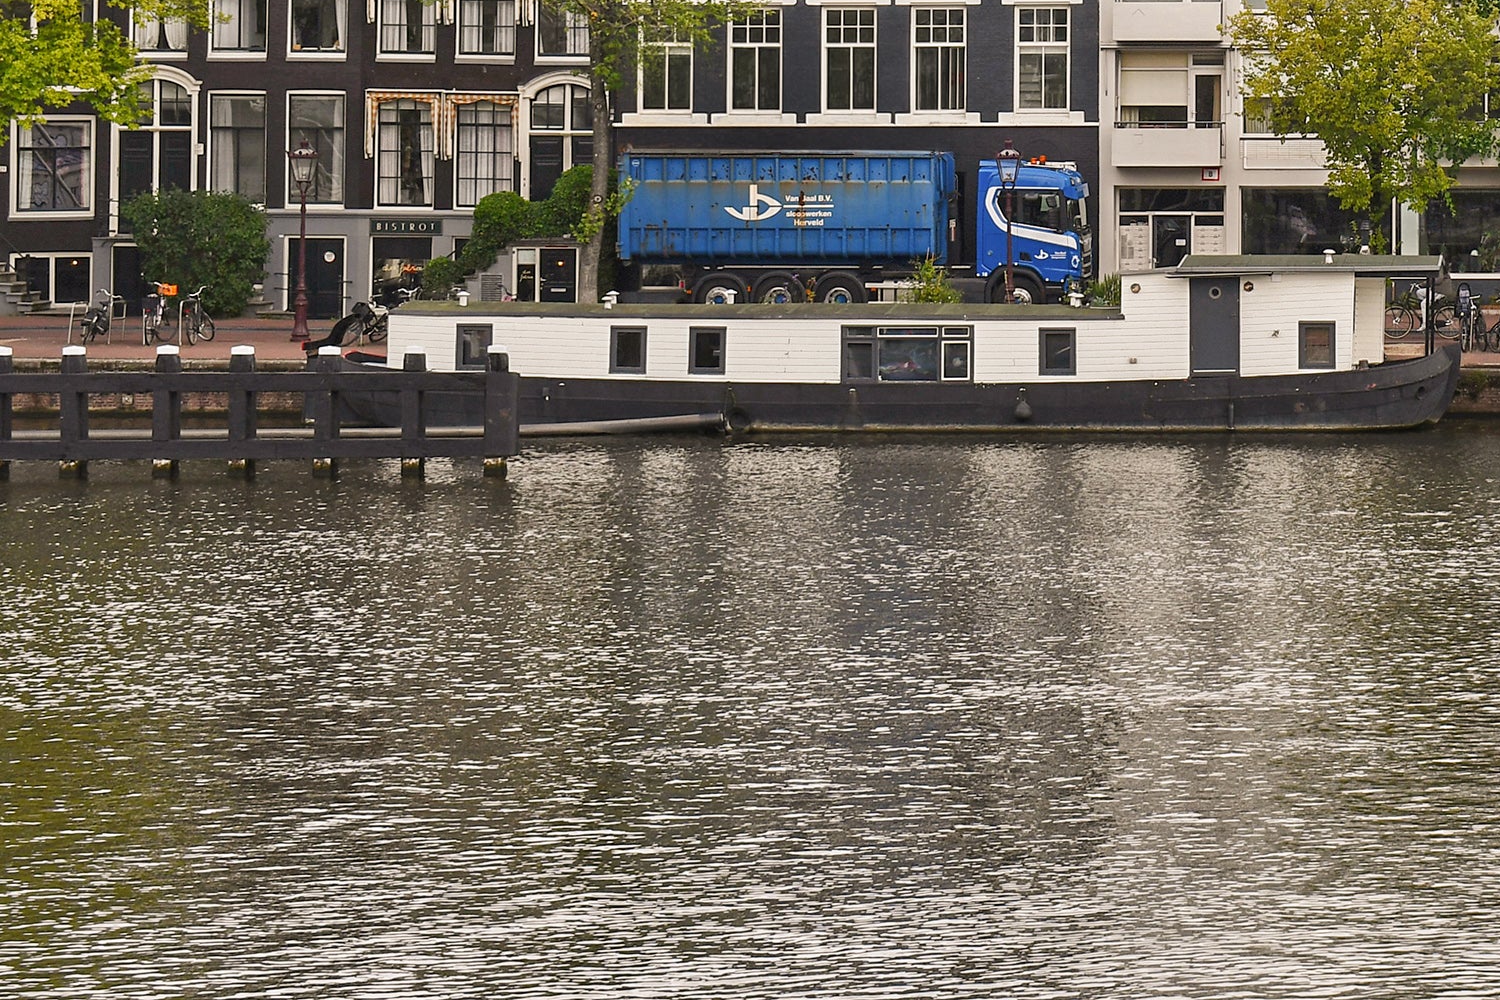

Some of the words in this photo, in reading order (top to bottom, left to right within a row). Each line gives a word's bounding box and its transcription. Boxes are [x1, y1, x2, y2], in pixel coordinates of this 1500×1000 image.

[784, 194, 800, 202] Van
[818, 194, 833, 202] B.V.
[376, 222, 435, 231] BISTROT
